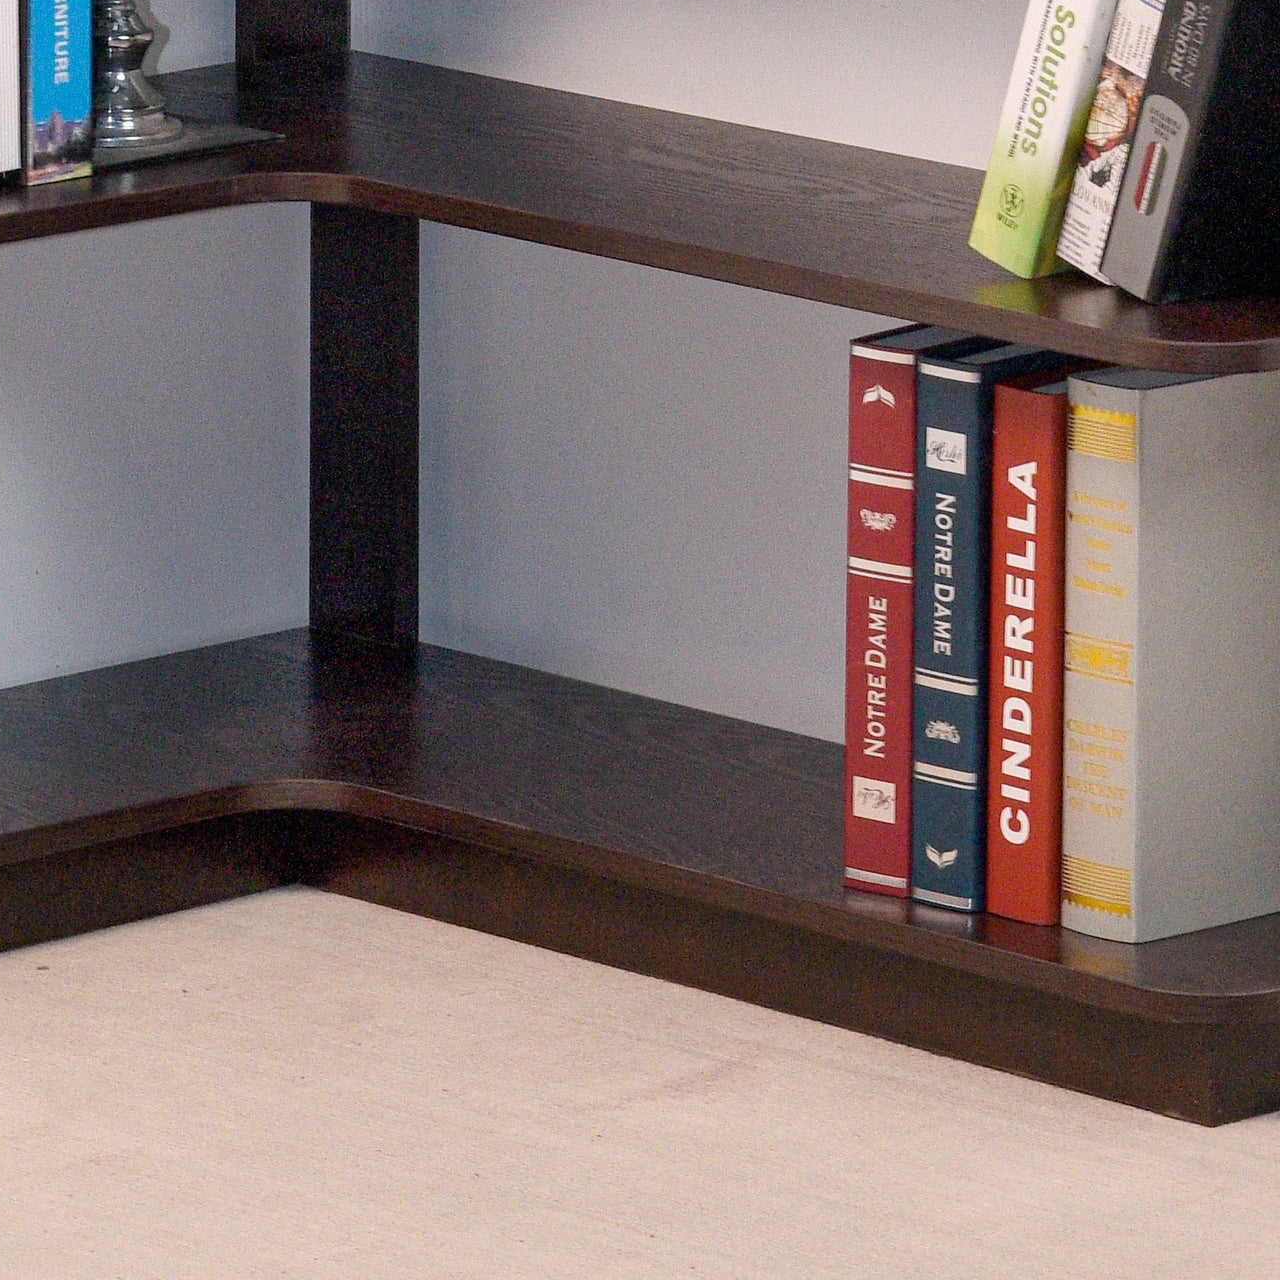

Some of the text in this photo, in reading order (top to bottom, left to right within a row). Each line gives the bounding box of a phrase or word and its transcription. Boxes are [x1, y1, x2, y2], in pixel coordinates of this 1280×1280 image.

[1021, 4, 1077, 157] Solutions
[1168, 0, 1197, 82] AROUND
[933, 492, 957, 656] NOTRE DAME
[1000, 460, 1039, 845] CINDERELLA
[863, 596, 888, 758] NOTRE DAME
